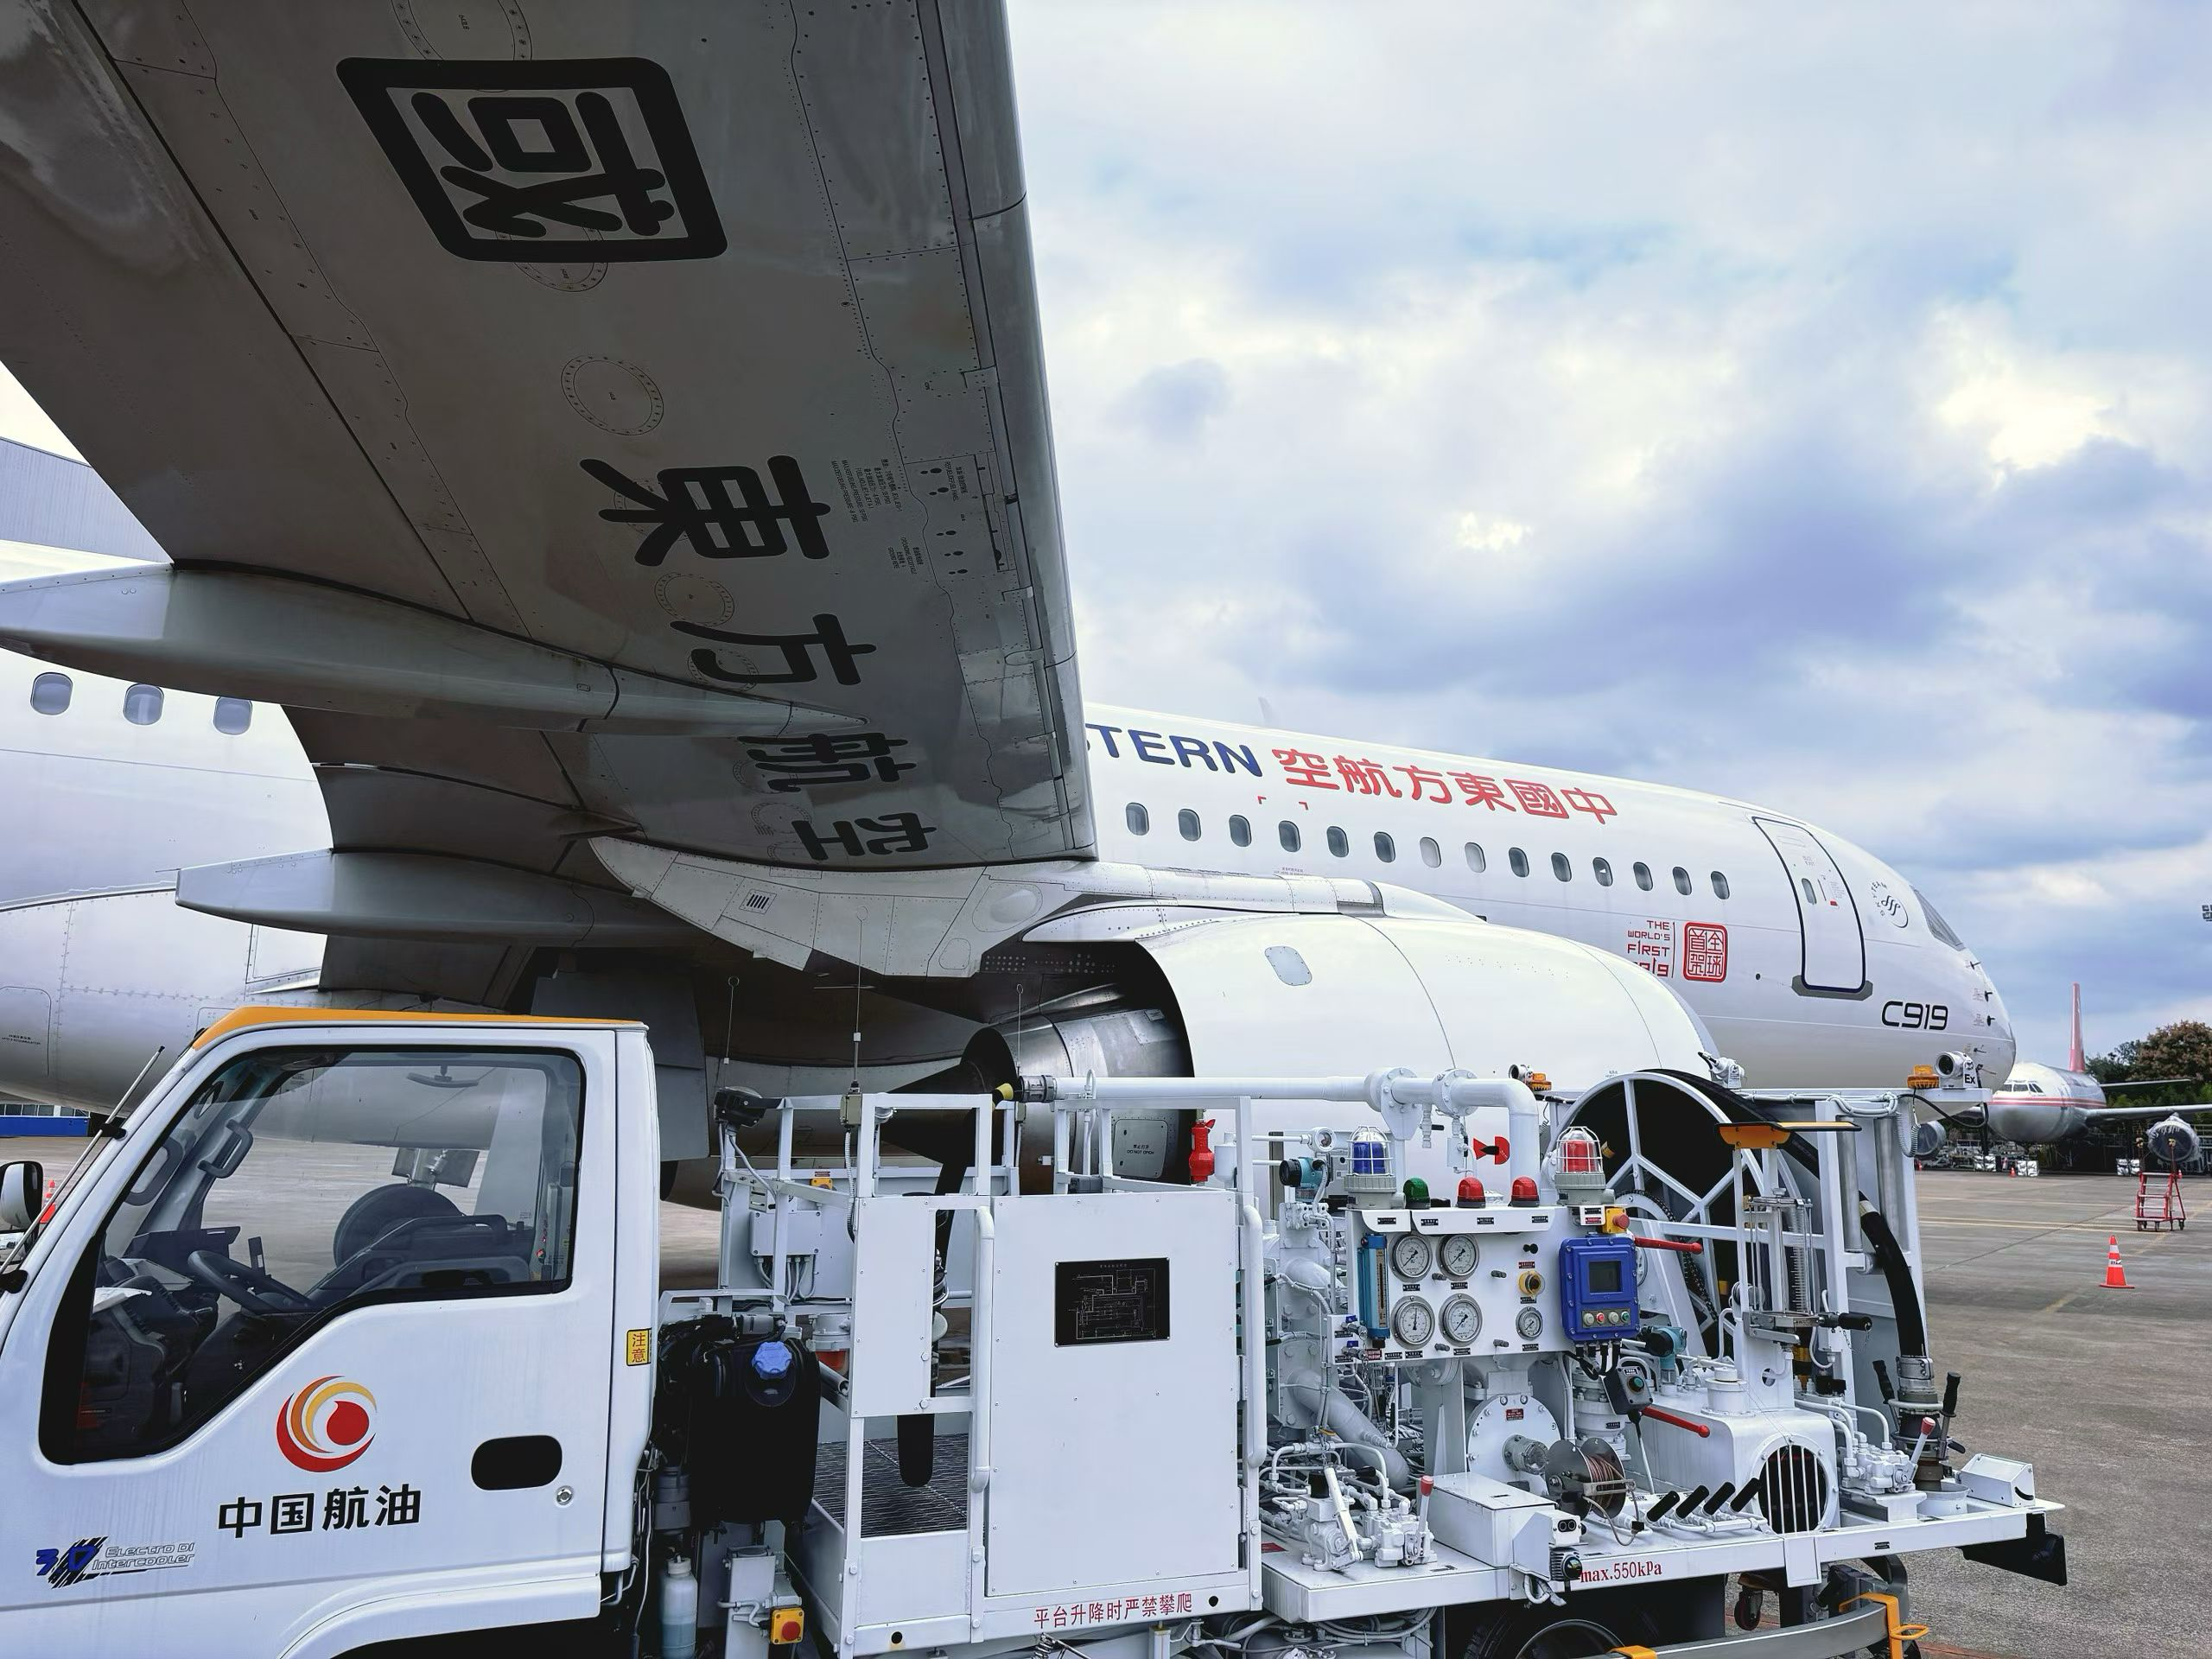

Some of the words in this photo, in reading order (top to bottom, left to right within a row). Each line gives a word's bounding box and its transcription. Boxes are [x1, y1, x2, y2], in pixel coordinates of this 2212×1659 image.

[1085, 723, 1262, 777] TERN
[1627, 930, 1670, 941] WORLD'S
[1646, 920, 1670, 931] THE
[1627, 940, 1670, 957] FIRST
[1632, 957, 1669, 977] 019
[1882, 1001, 1948, 1030] C919
[1964, 1073, 1975, 1084] Ex
[632, 1332, 645, 1363] 注意
[218, 1484, 422, 1538] 中国航油
[1580, 1560, 1662, 1584] max.550kPa
[1034, 1592, 1192, 1630] 平台升降时严禁攀爬
